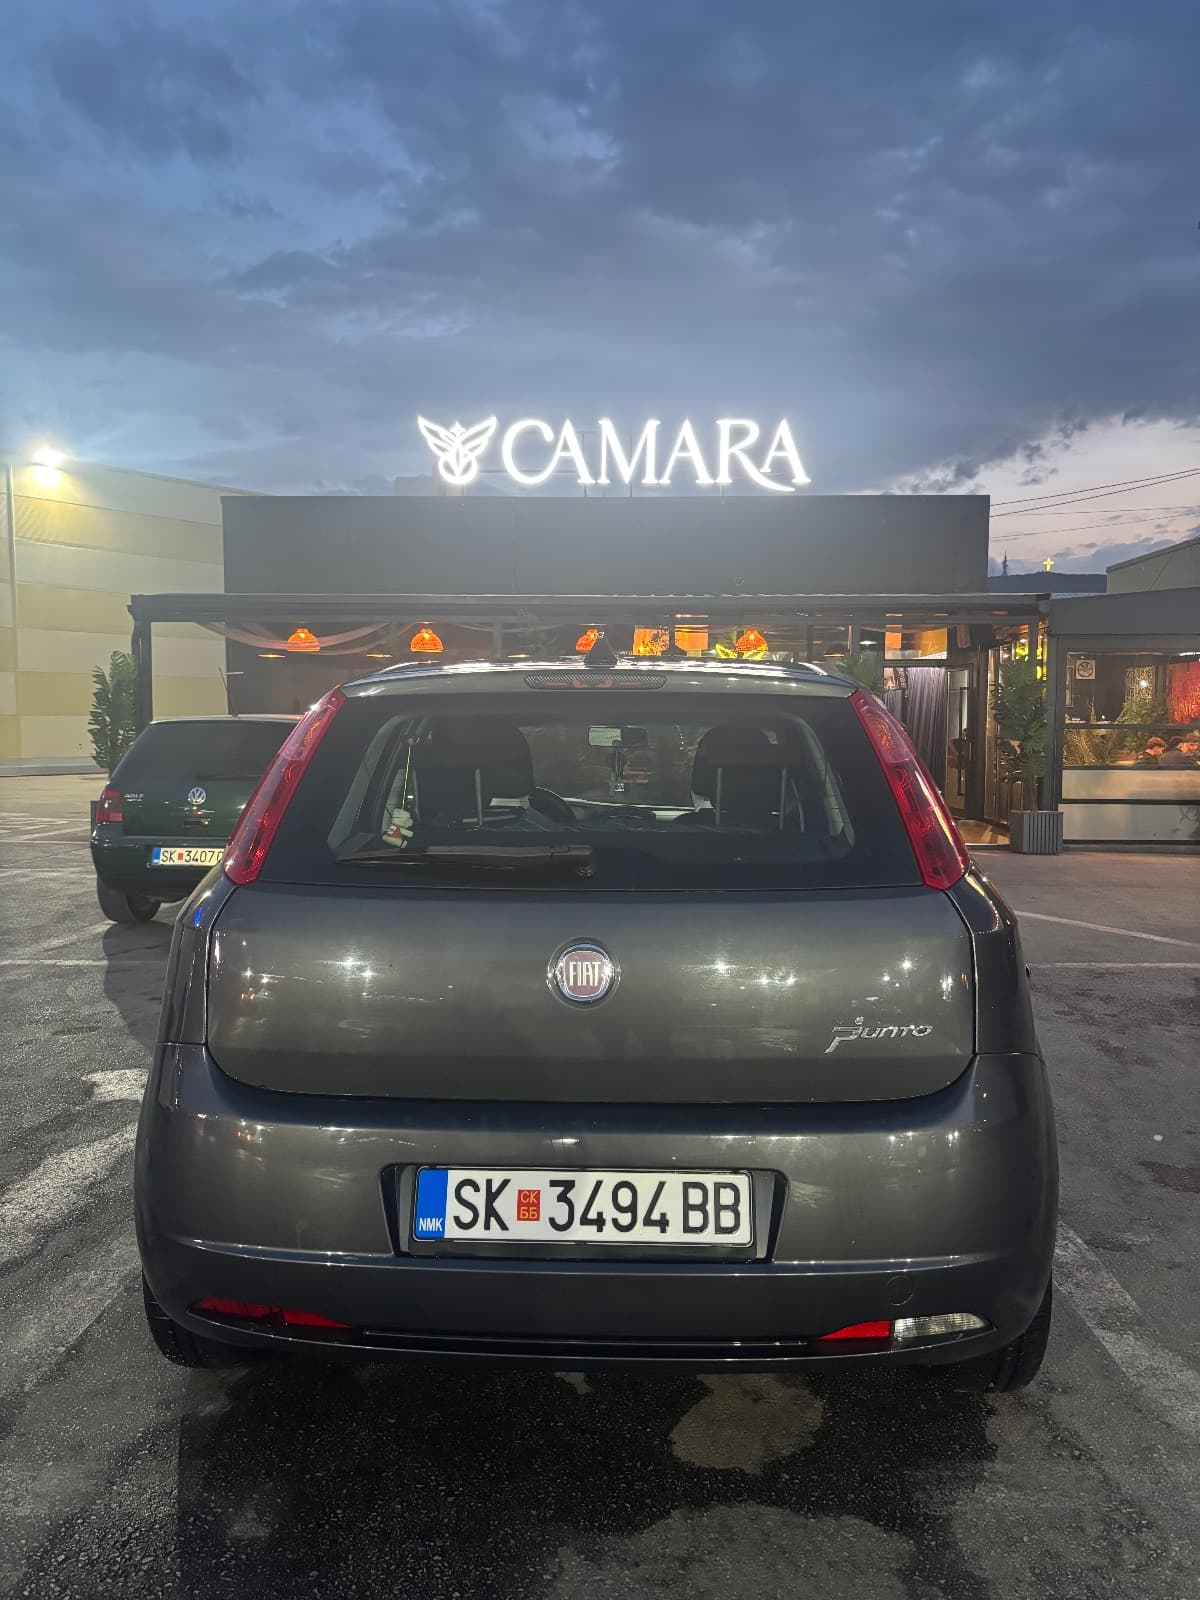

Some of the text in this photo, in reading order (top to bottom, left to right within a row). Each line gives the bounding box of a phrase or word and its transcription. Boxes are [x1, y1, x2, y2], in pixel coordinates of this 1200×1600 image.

[501, 417, 812, 492] CAMARA
[161, 850, 177, 863] SK
[569, 961, 602, 987] FIAT
[453, 1178, 741, 1235] SK 3494 BB
[418, 1217, 443, 1232] NMK
